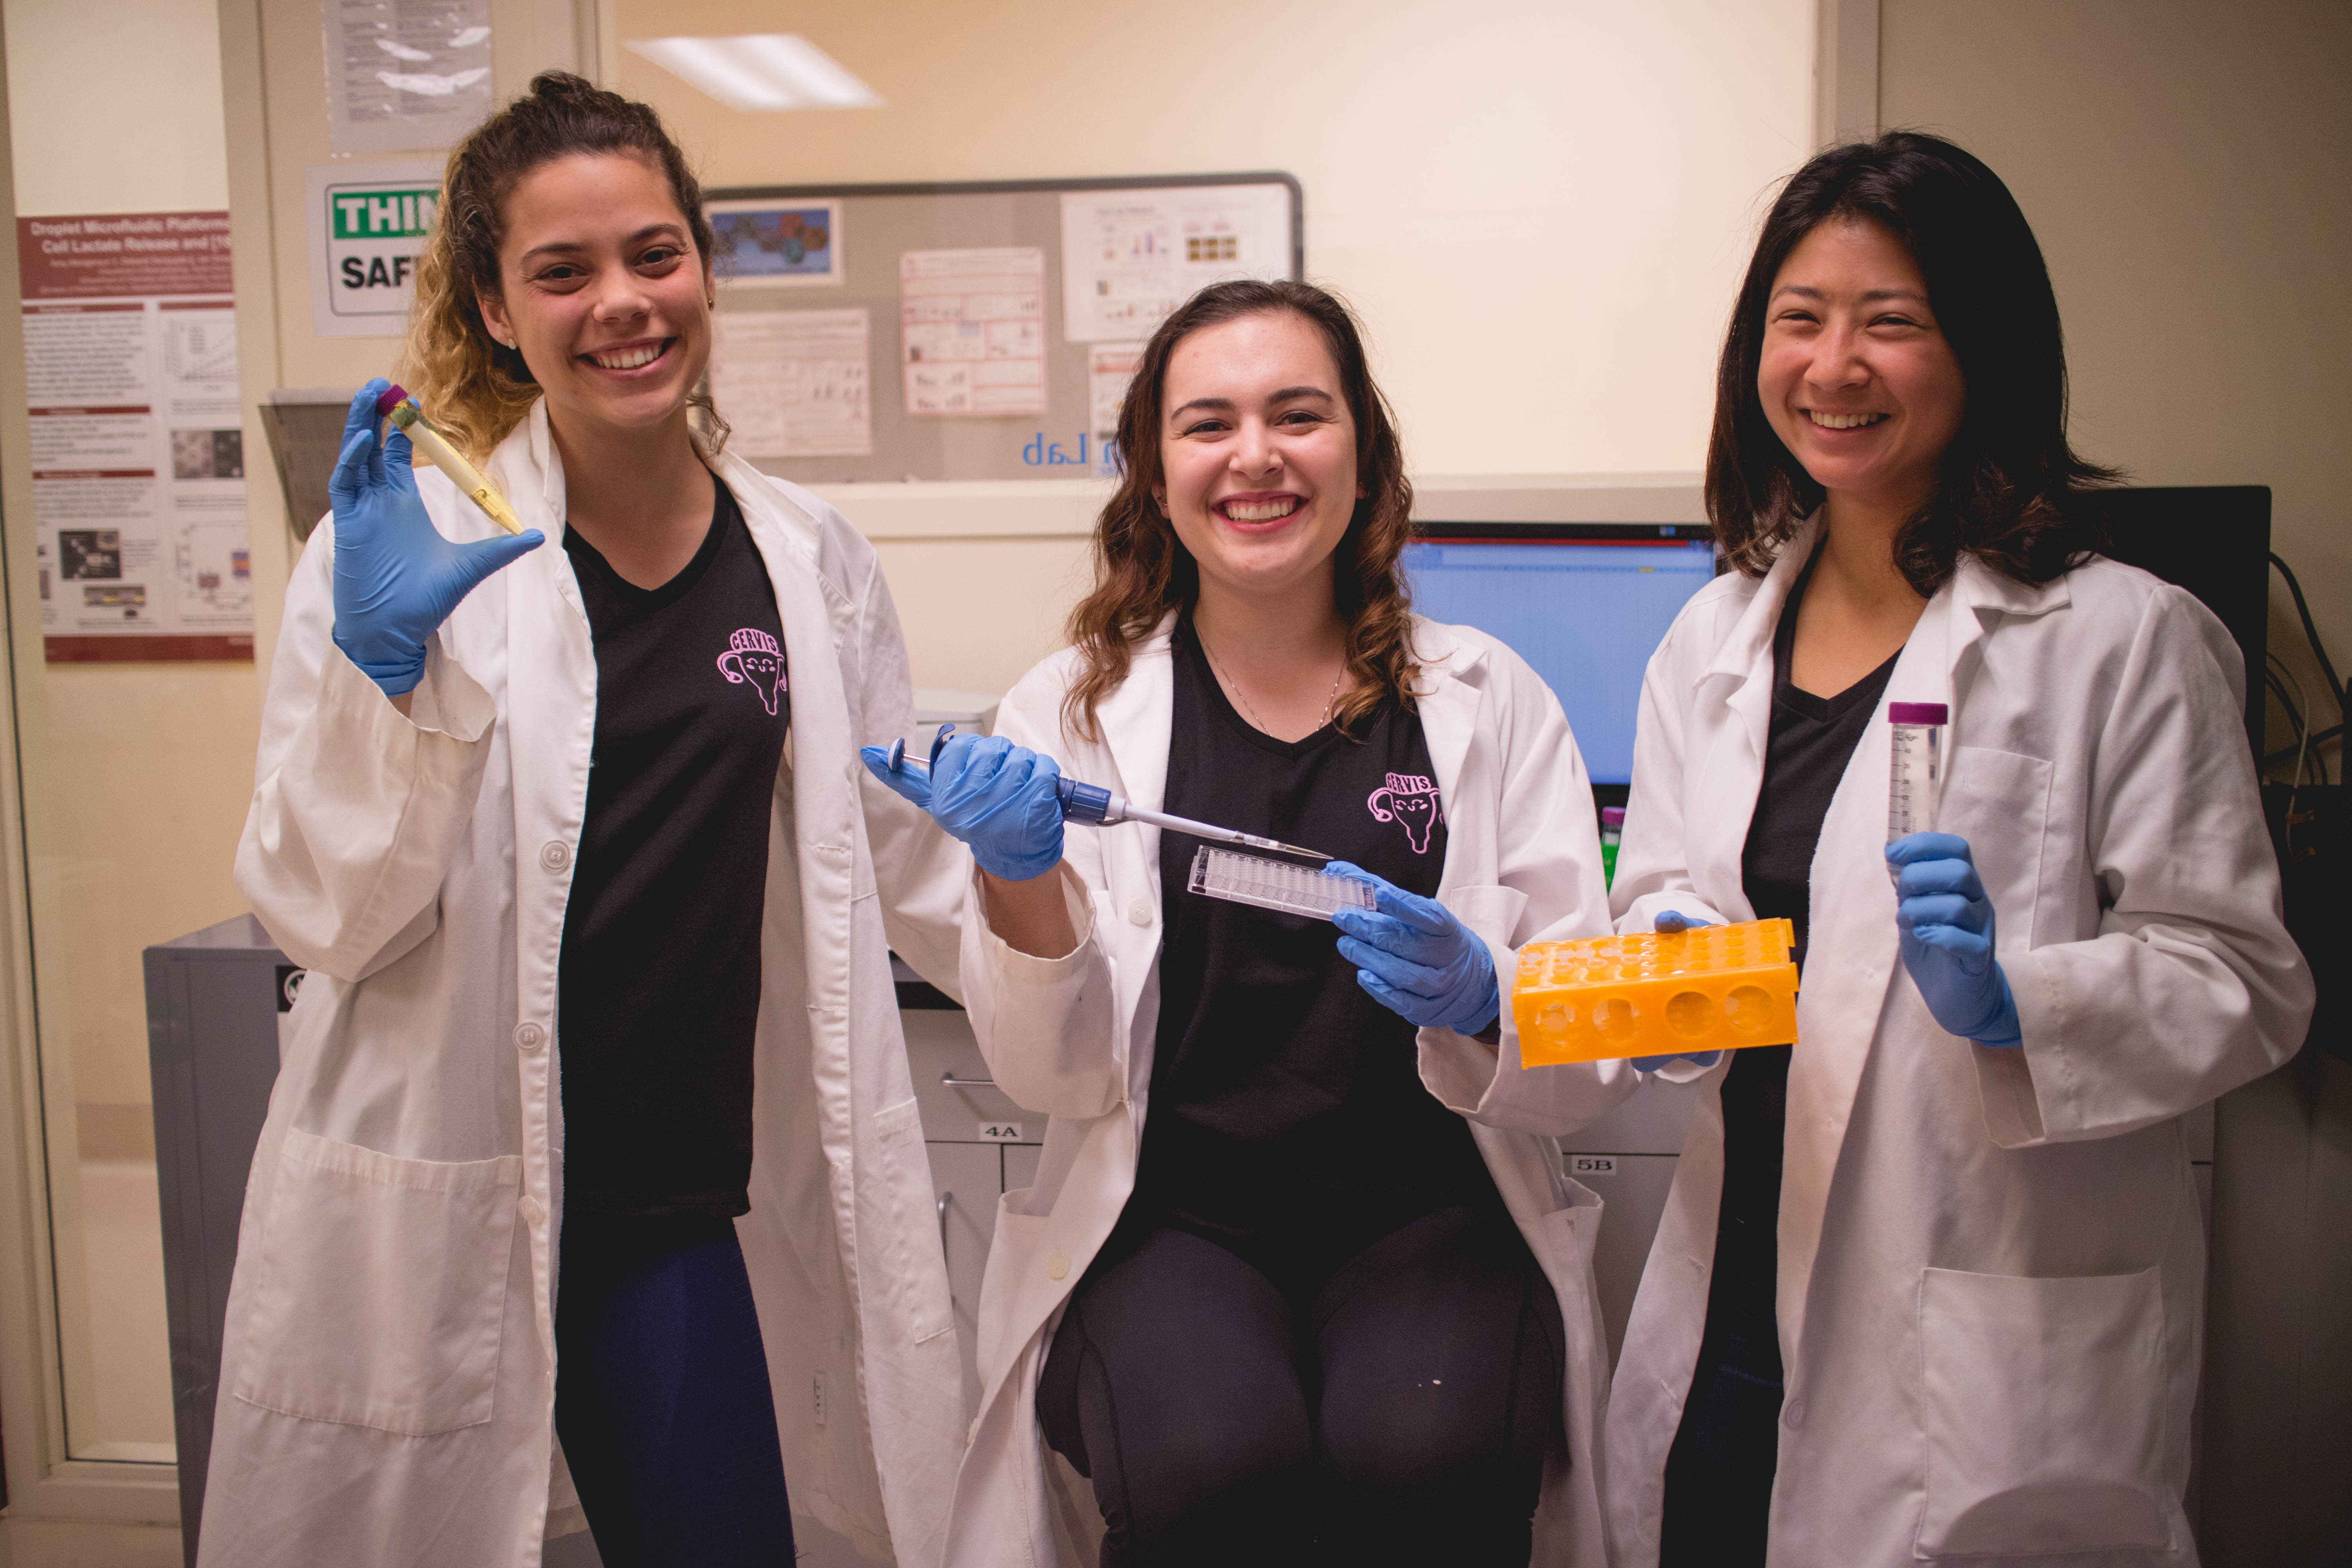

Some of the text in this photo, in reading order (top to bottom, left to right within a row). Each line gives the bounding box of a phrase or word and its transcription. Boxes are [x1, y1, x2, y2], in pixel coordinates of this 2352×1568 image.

[336, 196, 439, 232] THIN
[31, 222, 81, 236] Droplet
[341, 256, 419, 289] SAF
[730, 628, 778, 653] CERVIS
[1386, 773, 1430, 793] CERVIS
[985, 1126, 1018, 1137] 4A
[1577, 1159, 1613, 1171] 5B
